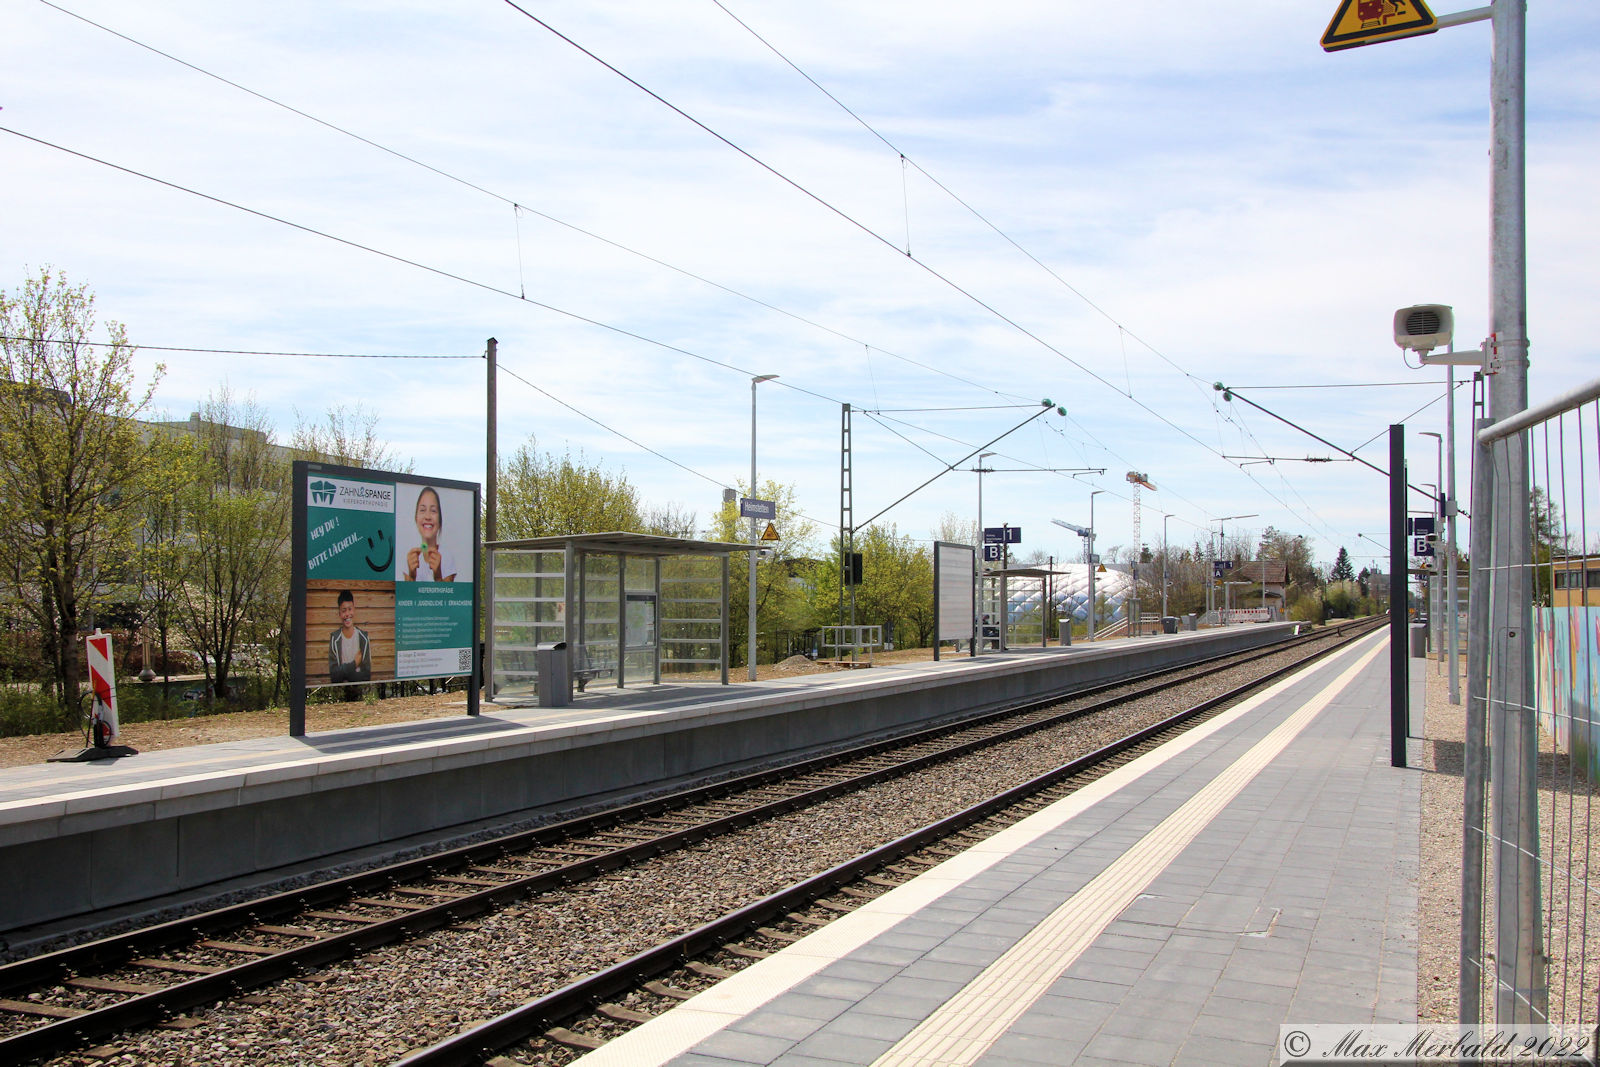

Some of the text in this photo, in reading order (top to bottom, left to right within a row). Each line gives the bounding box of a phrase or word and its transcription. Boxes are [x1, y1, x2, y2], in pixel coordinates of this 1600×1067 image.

[310, 525, 325, 540] HEY
[1006, 528, 1013, 541] 1
[989, 546, 999, 559] B
[1416, 539, 1428, 553] B
[307, 550, 329, 570] BITTE
